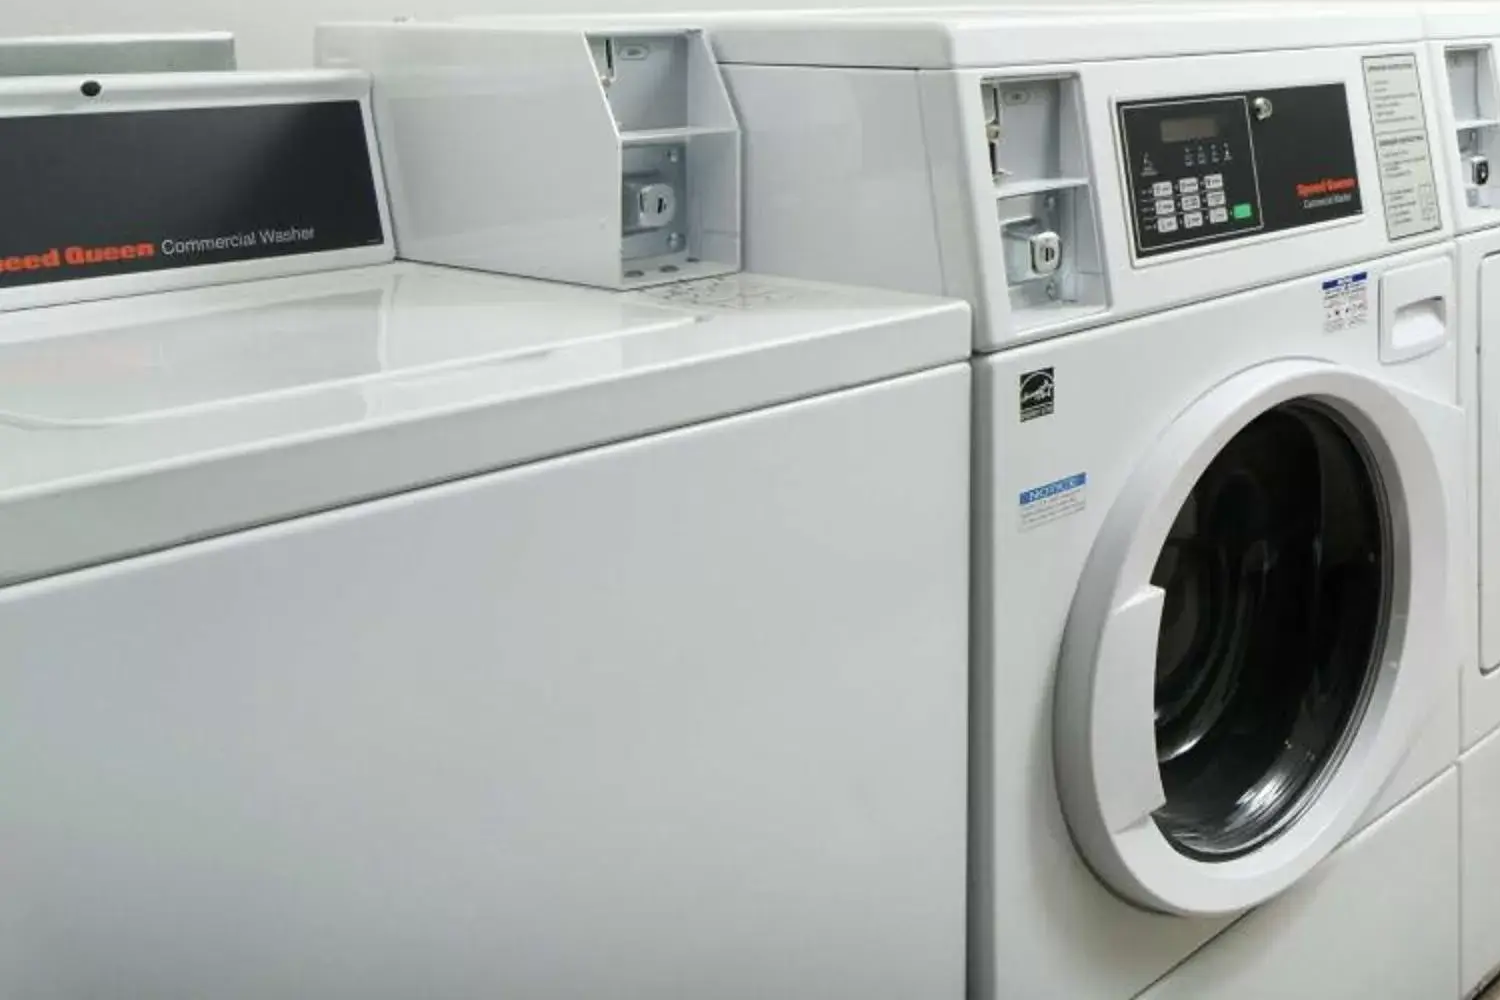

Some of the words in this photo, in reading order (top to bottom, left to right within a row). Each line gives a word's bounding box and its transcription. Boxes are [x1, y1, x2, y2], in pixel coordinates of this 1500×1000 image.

[0, 247, 60, 273] eed
[65, 242, 155, 265] Queen
[161, 231, 256, 256] Commercial
[260, 226, 315, 245] Washer
